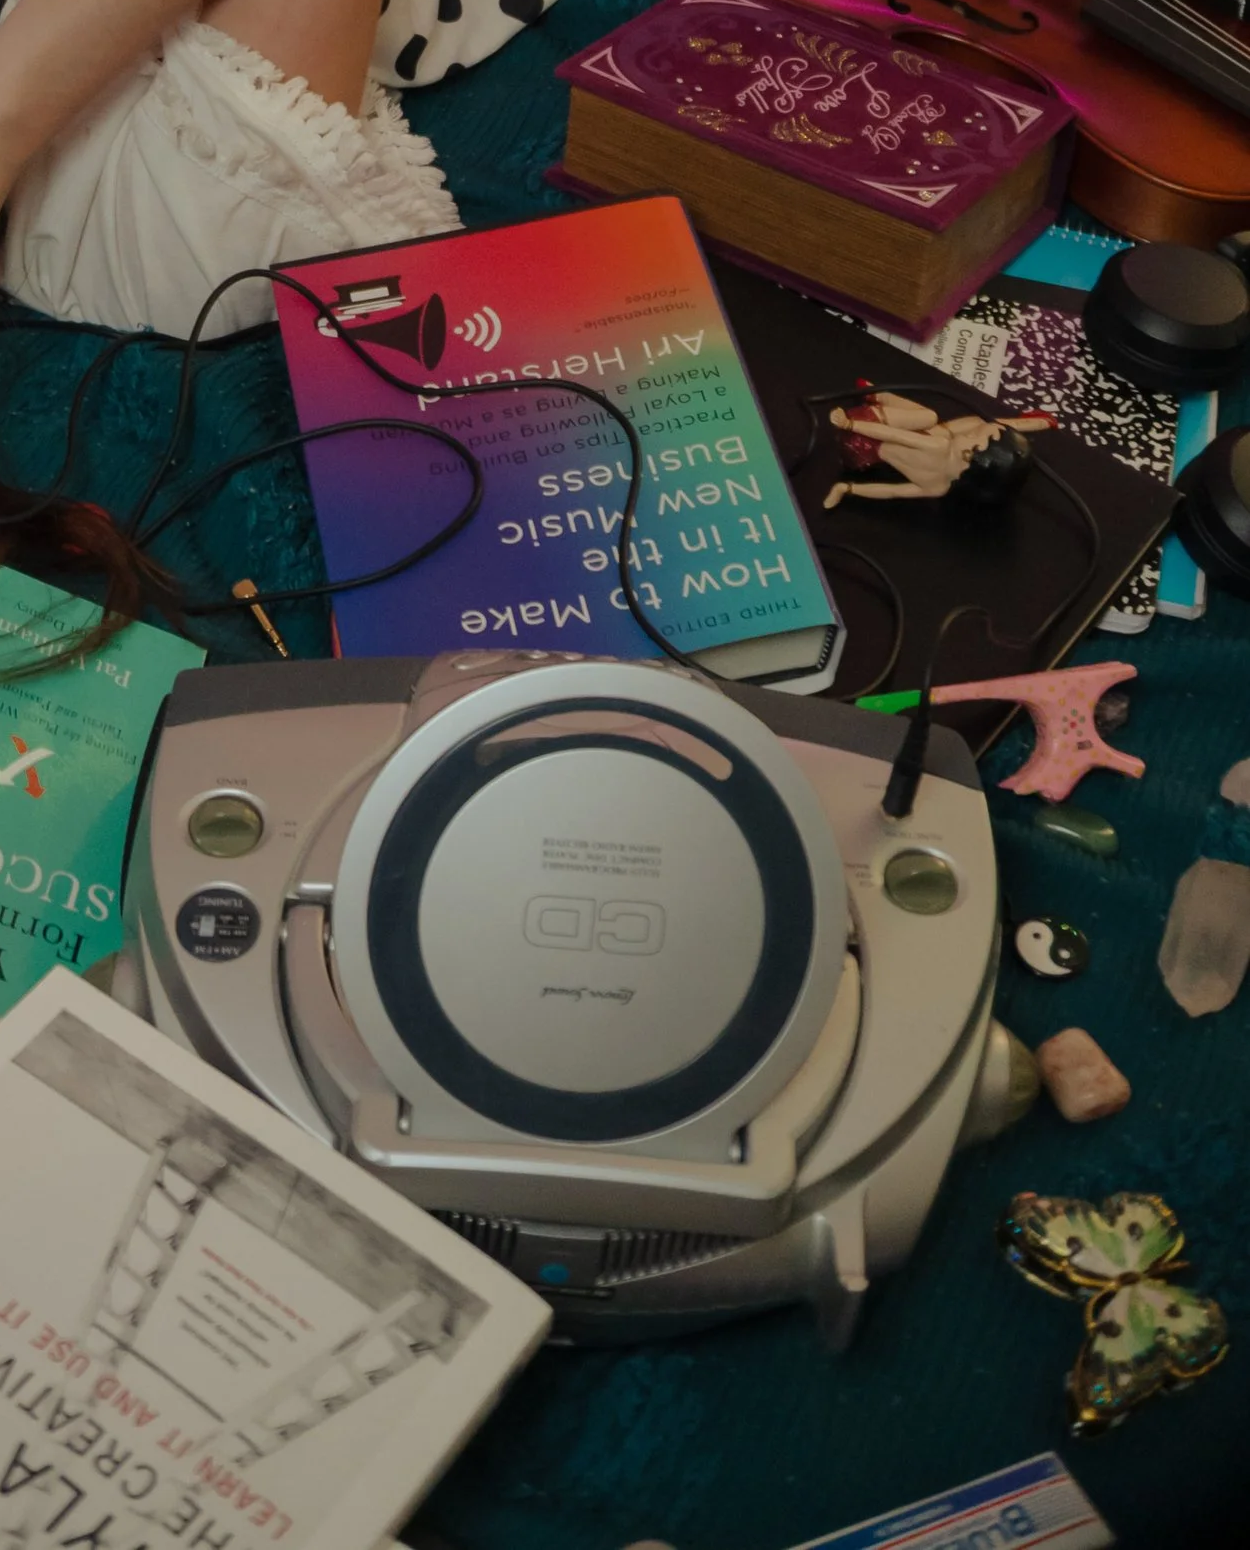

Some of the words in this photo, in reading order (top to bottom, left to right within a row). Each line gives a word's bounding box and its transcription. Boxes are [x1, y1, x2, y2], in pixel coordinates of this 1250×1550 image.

[734, 52, 833, 114] Spells
[813, 61, 889, 117] Love
[887, 94, 947, 133] Book
[641, 328, 708, 367] Ari
[968, 332, 998, 390] Staples
[615, 383, 628, 396] a
[635, 363, 720, 393] Making
[714, 384, 727, 398] a
[480, 411, 494, 424] a
[501, 404, 527, 421] as
[534, 388, 607, 415] Lving
[643, 387, 707, 415] Loyal
[466, 429, 511, 449] and
[573, 428, 624, 452] Tips
[636, 405, 735, 440] Practica
[428, 446, 528, 479] Builing
[534, 441, 565, 458] on
[653, 472, 761, 520] New
[497, 500, 637, 552] Music
[678, 523, 723, 559] in
[738, 511, 775, 547] It
[580, 536, 663, 580] the
[682, 552, 789, 600] How
[610, 580, 660, 610] to
[738, 596, 800, 619] THIRD
[460, 593, 590, 635] Make
[660, 611, 730, 637] EDITIO
[92, 657, 132, 687] Pat
[198, 896, 242, 906] TUNING
[522, 894, 666, 956] CD
[28, 1321, 94, 1380] USE
[90, 1370, 161, 1432] AND
[155, 1424, 195, 1463] IT
[192, 1450, 297, 1541] LEARN
